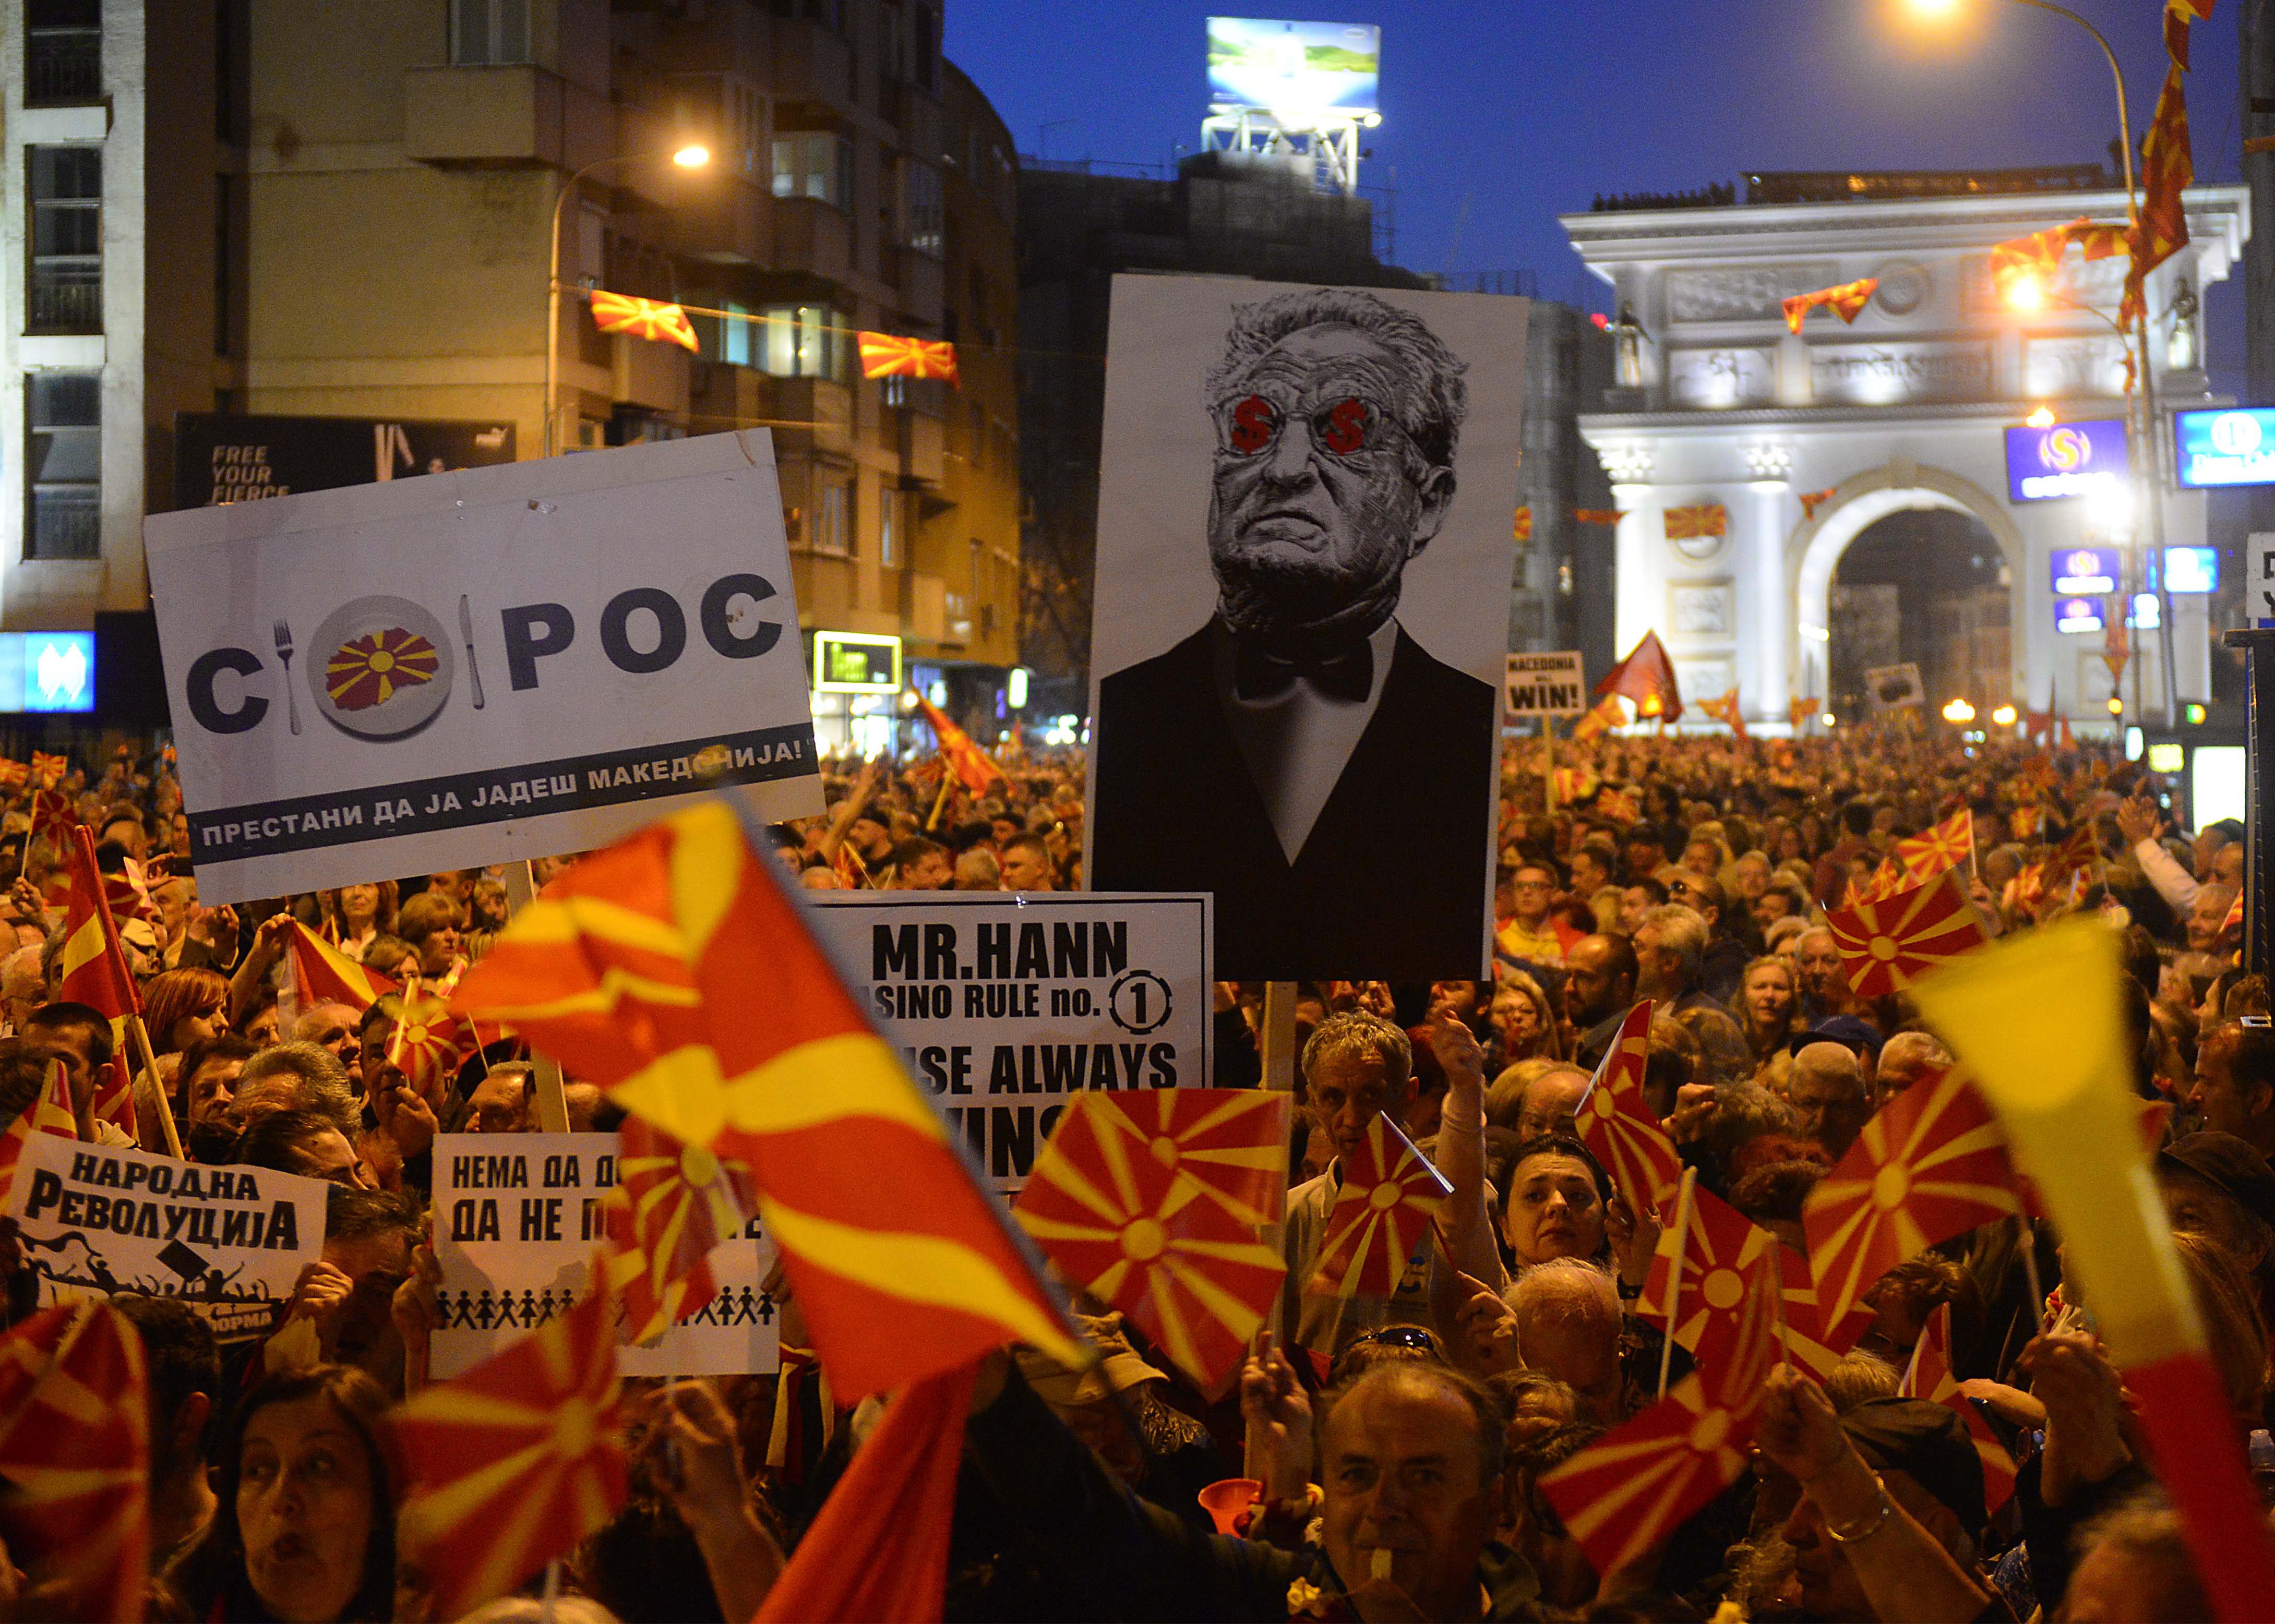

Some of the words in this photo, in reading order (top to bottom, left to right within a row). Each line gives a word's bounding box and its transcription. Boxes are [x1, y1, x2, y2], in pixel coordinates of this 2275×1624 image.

[212, 446, 267, 464] FREE
[212, 465, 272, 484] YOUR
[1510, 683, 1578, 709] WIN!
[202, 806, 363, 846] ПРЕСТАНИ
[374, 799, 415, 826] ДА
[425, 792, 462, 814] ЈА
[472, 773, 577, 808] ЈАДЕШ
[858, 984, 952, 1019] SINO
[964, 983, 1039, 1018] RULE
[1051, 988, 1101, 1017] no.
[1130, 982, 1147, 1024] 1
[989, 1042, 1177, 1094] ALWAYS
[70, 1151, 261, 1201] НАРОДНА
[452, 1155, 528, 1188] НЕМА
[543, 1155, 581, 1188] ДА
[452, 1199, 500, 1242] ДА
[520, 1198, 562, 1242] НЕ
